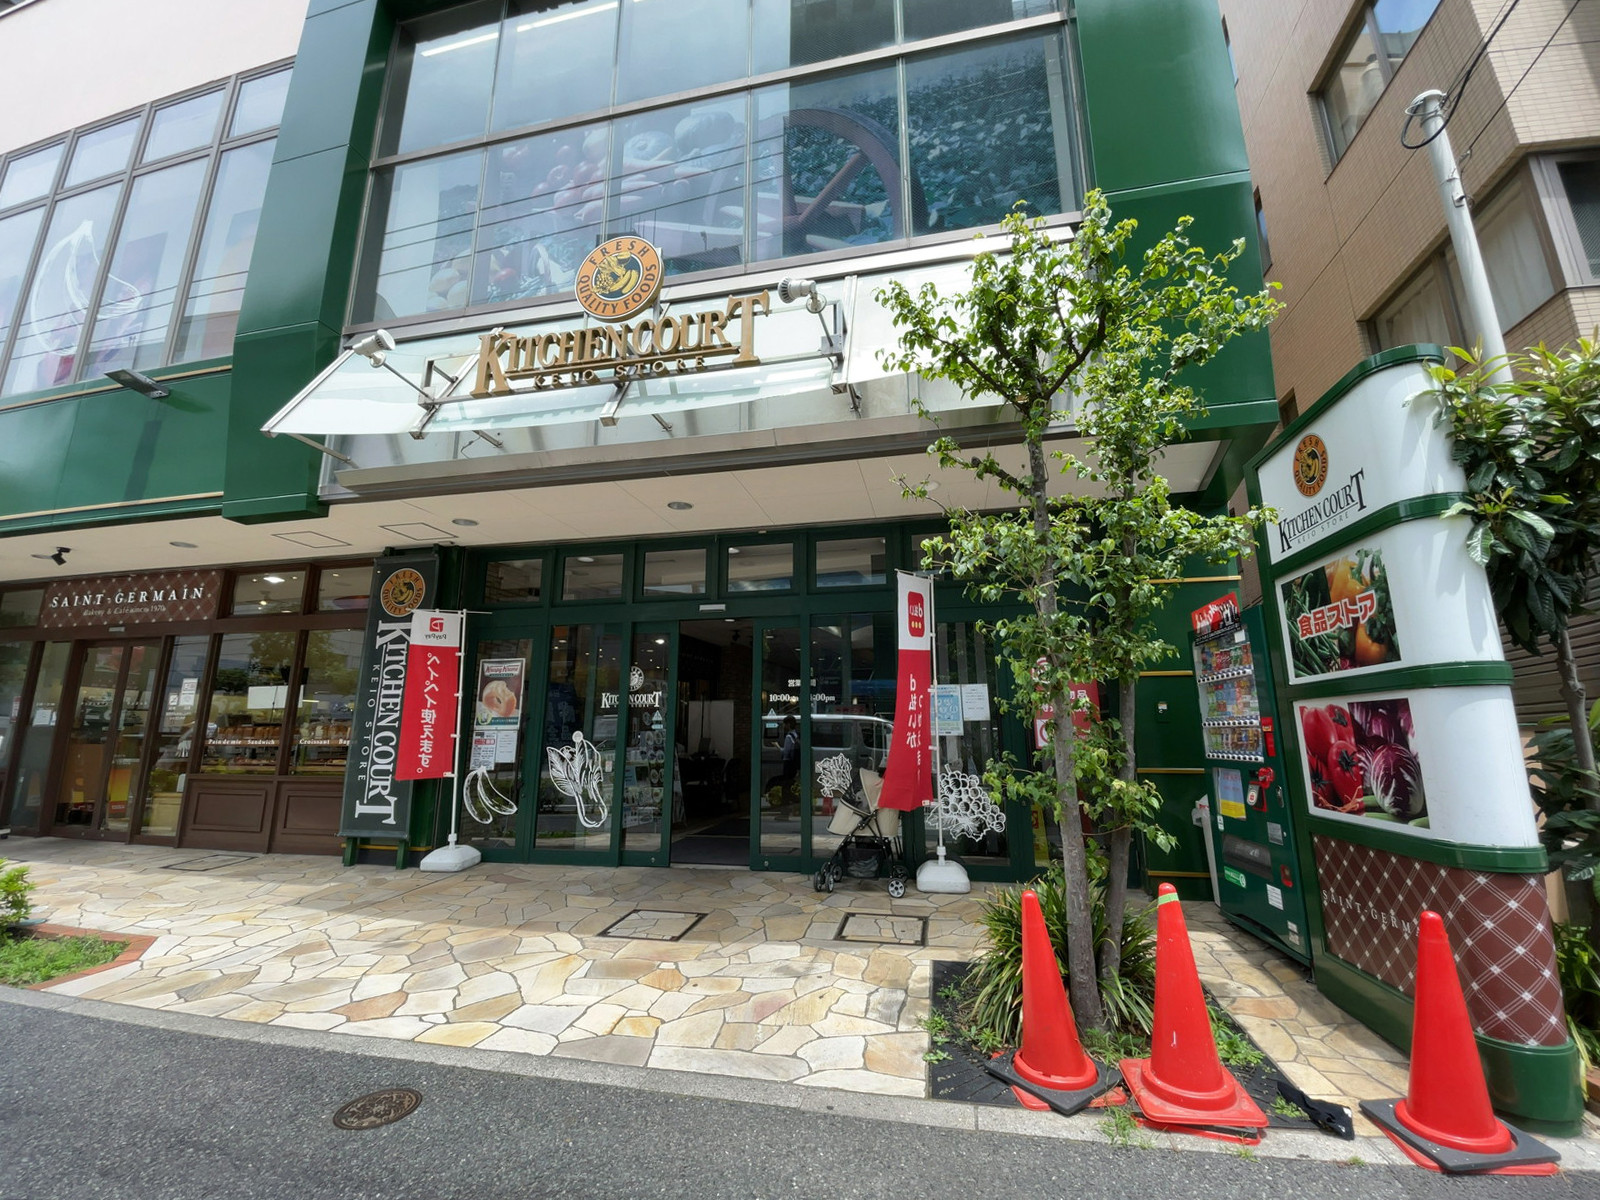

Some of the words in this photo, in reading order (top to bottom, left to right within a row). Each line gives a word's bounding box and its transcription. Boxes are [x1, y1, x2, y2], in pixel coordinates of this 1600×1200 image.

[588, 240, 650, 266] FRESH
[579, 274, 619, 314] QUALITY
[622, 263, 657, 310] FOODS
[470, 326, 629, 399] KITCHEN
[630, 289, 771, 368] COURT
[533, 369, 599, 390] KEIO
[614, 355, 707, 379] STORE
[1295, 436, 1320, 462] FRESH
[1294, 469, 1316, 495] QUALITY
[1316, 450, 1329, 489] FOODS
[1278, 502, 1323, 554] KITCHEN
[1323, 466, 1367, 519] COURT
[1296, 530, 1317, 544] KEIO
[1320, 511, 1350, 533] STORE
[50, 587, 205, 609] SAINT-GERMAIN
[389, 571, 420, 586] FRESH
[383, 588, 403, 614] QUALITY
[1297, 589, 1376, 640] 食品ストア
[367, 664, 380, 709] KEIO
[375, 619, 411, 728] KITCHEN
[634, 690, 663, 708] COURT
[810, 693, 836, 702] :00pm
[357, 720, 373, 781] STORE
[354, 730, 398, 825] COURT
